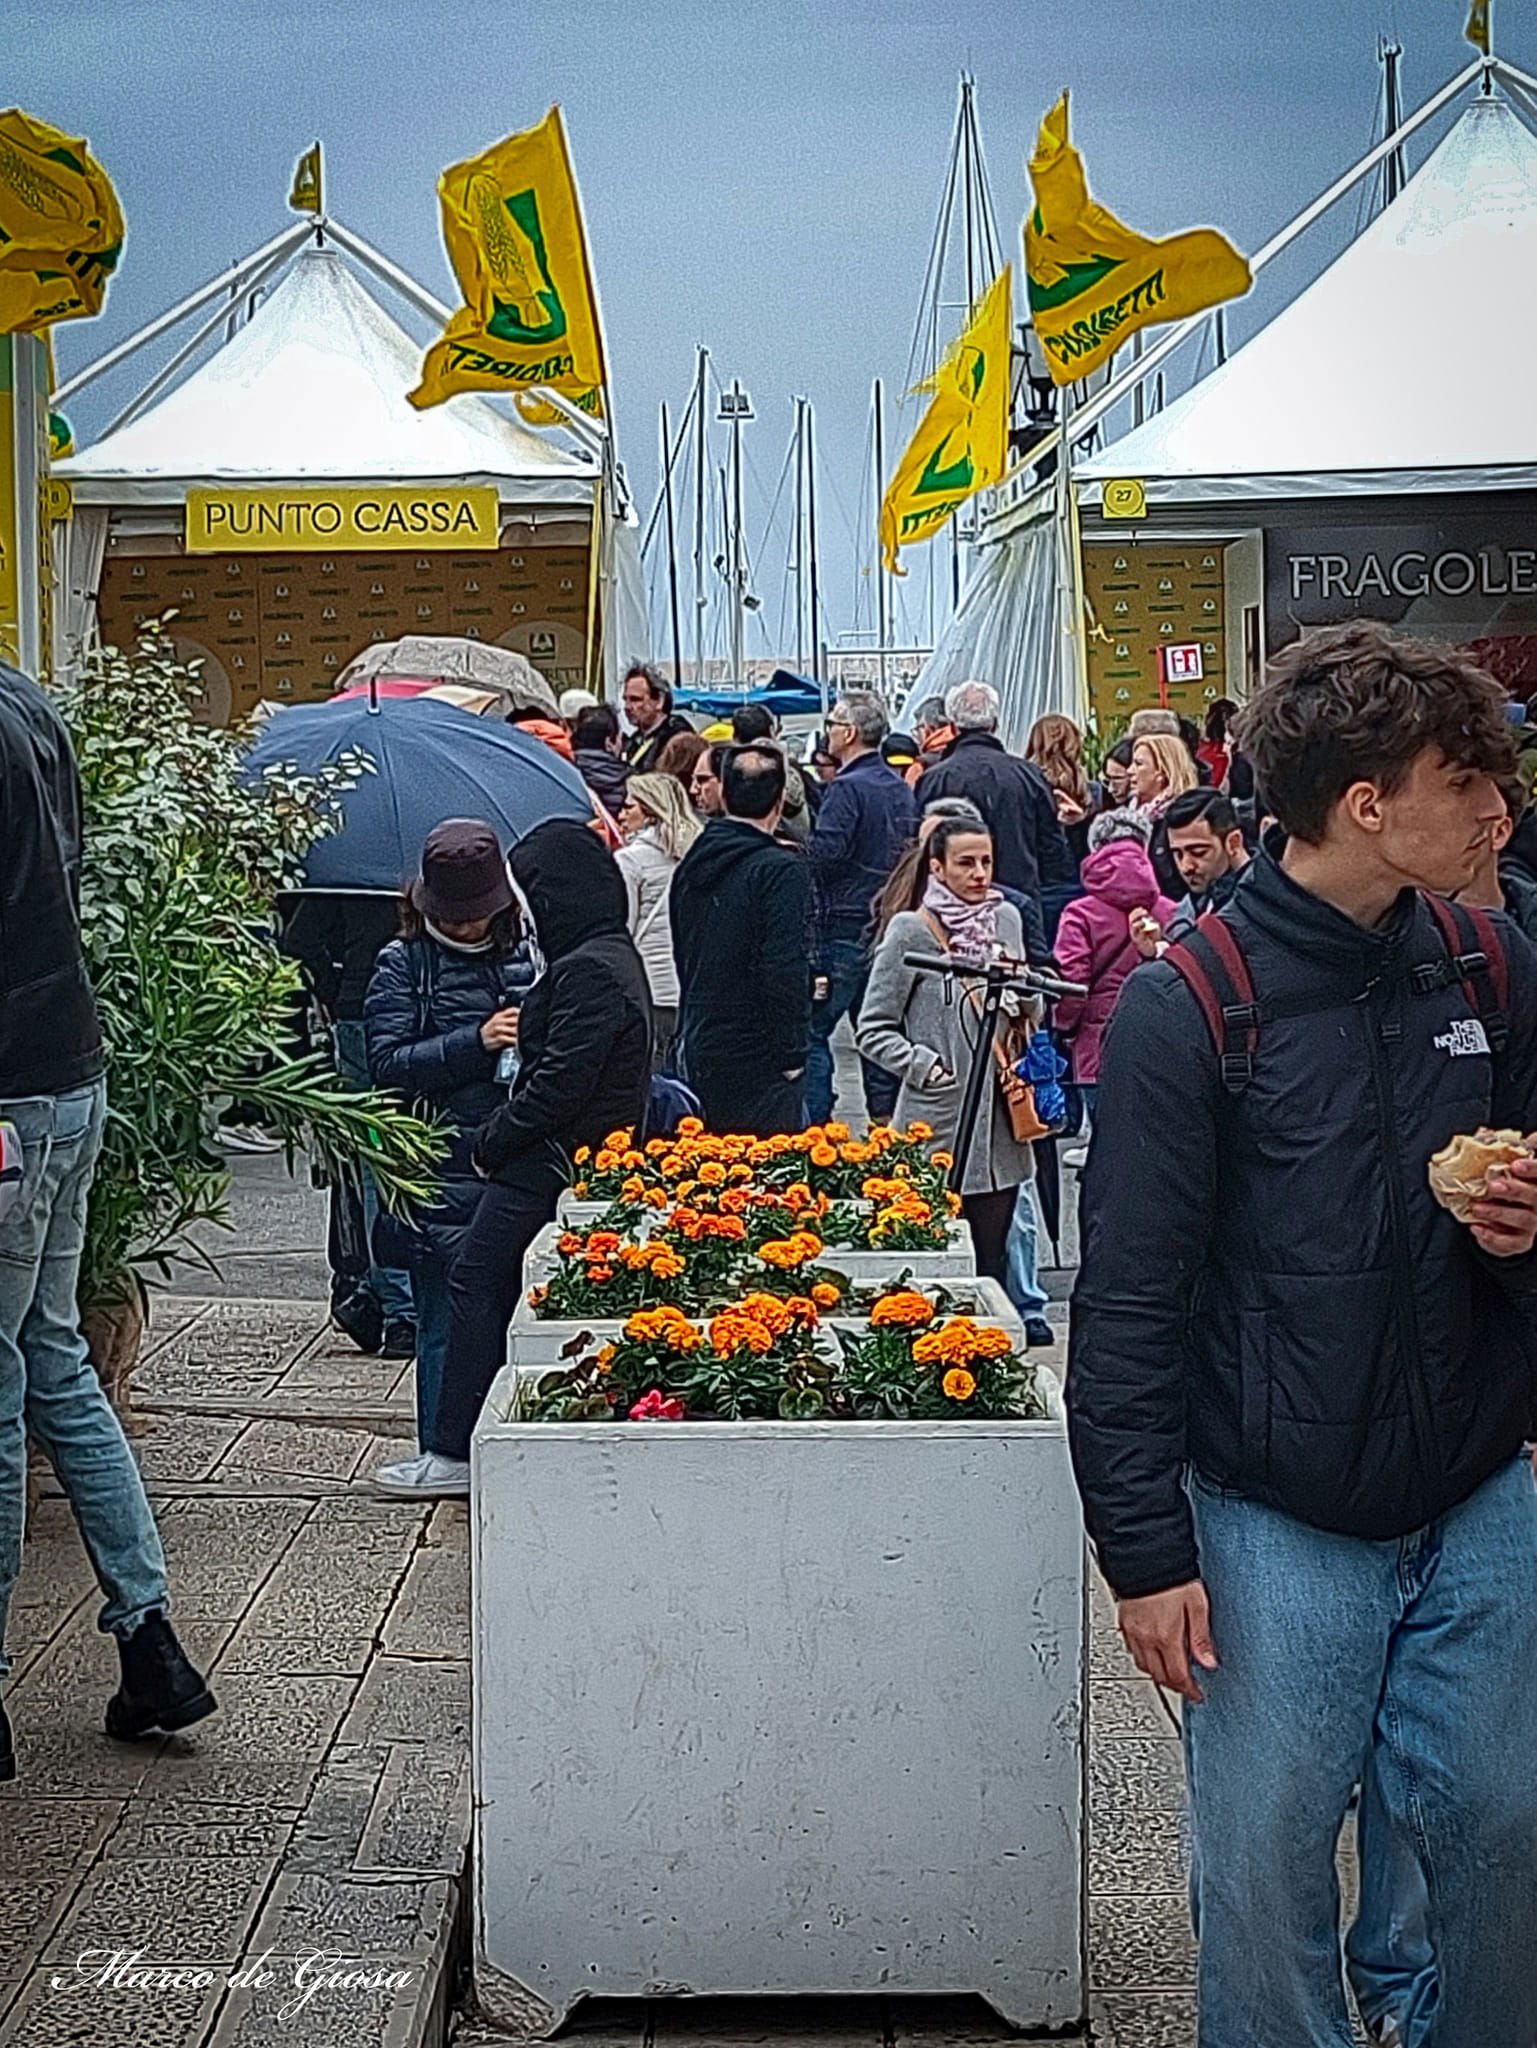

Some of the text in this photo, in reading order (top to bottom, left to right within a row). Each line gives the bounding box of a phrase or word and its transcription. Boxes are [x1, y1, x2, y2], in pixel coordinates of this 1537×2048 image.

[1115, 490, 1132, 502] 27
[205, 501, 479, 535] PUNTO CASSA
[1288, 551, 1537, 599] FRAGOLE
